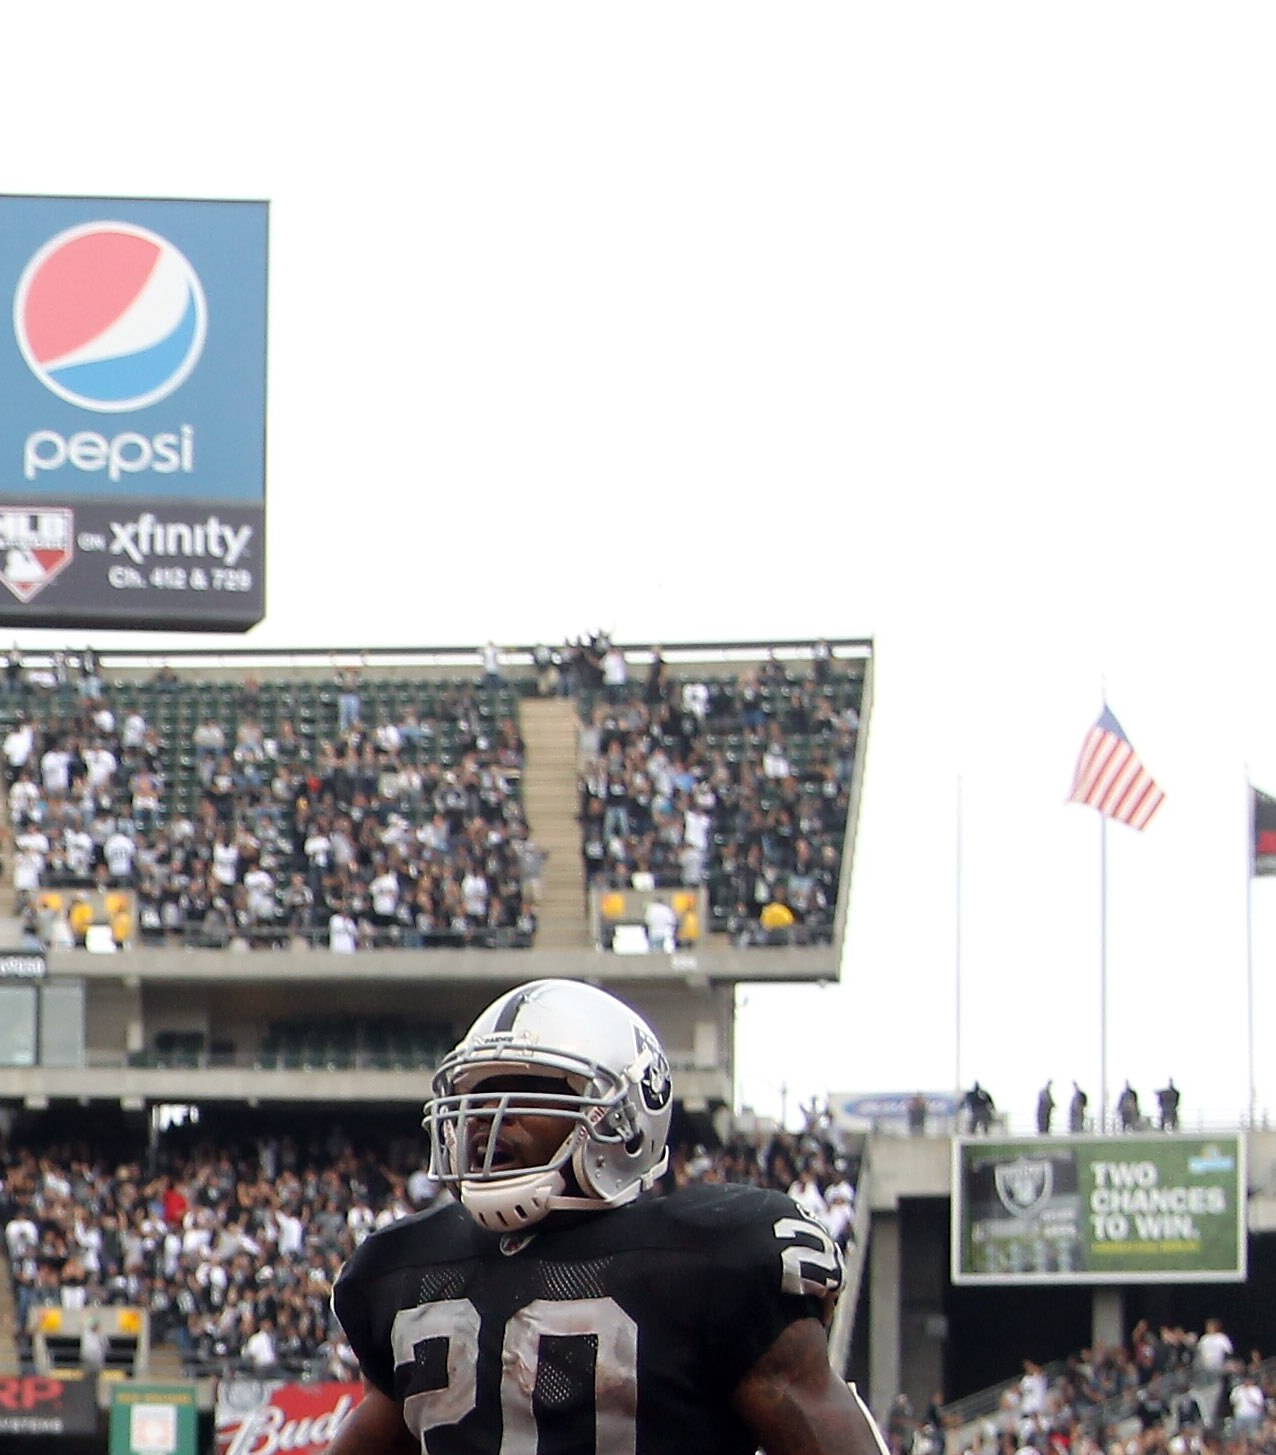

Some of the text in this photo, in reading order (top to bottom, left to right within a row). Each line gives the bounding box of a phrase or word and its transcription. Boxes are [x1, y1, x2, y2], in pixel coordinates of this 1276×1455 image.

[24, 423, 194, 481] pepsi
[110, 512, 253, 566] xfinity
[1090, 1160, 1159, 1188] TWO
[1090, 1186, 1228, 1215] CHANCES
[1090, 1213, 1130, 1241] TO
